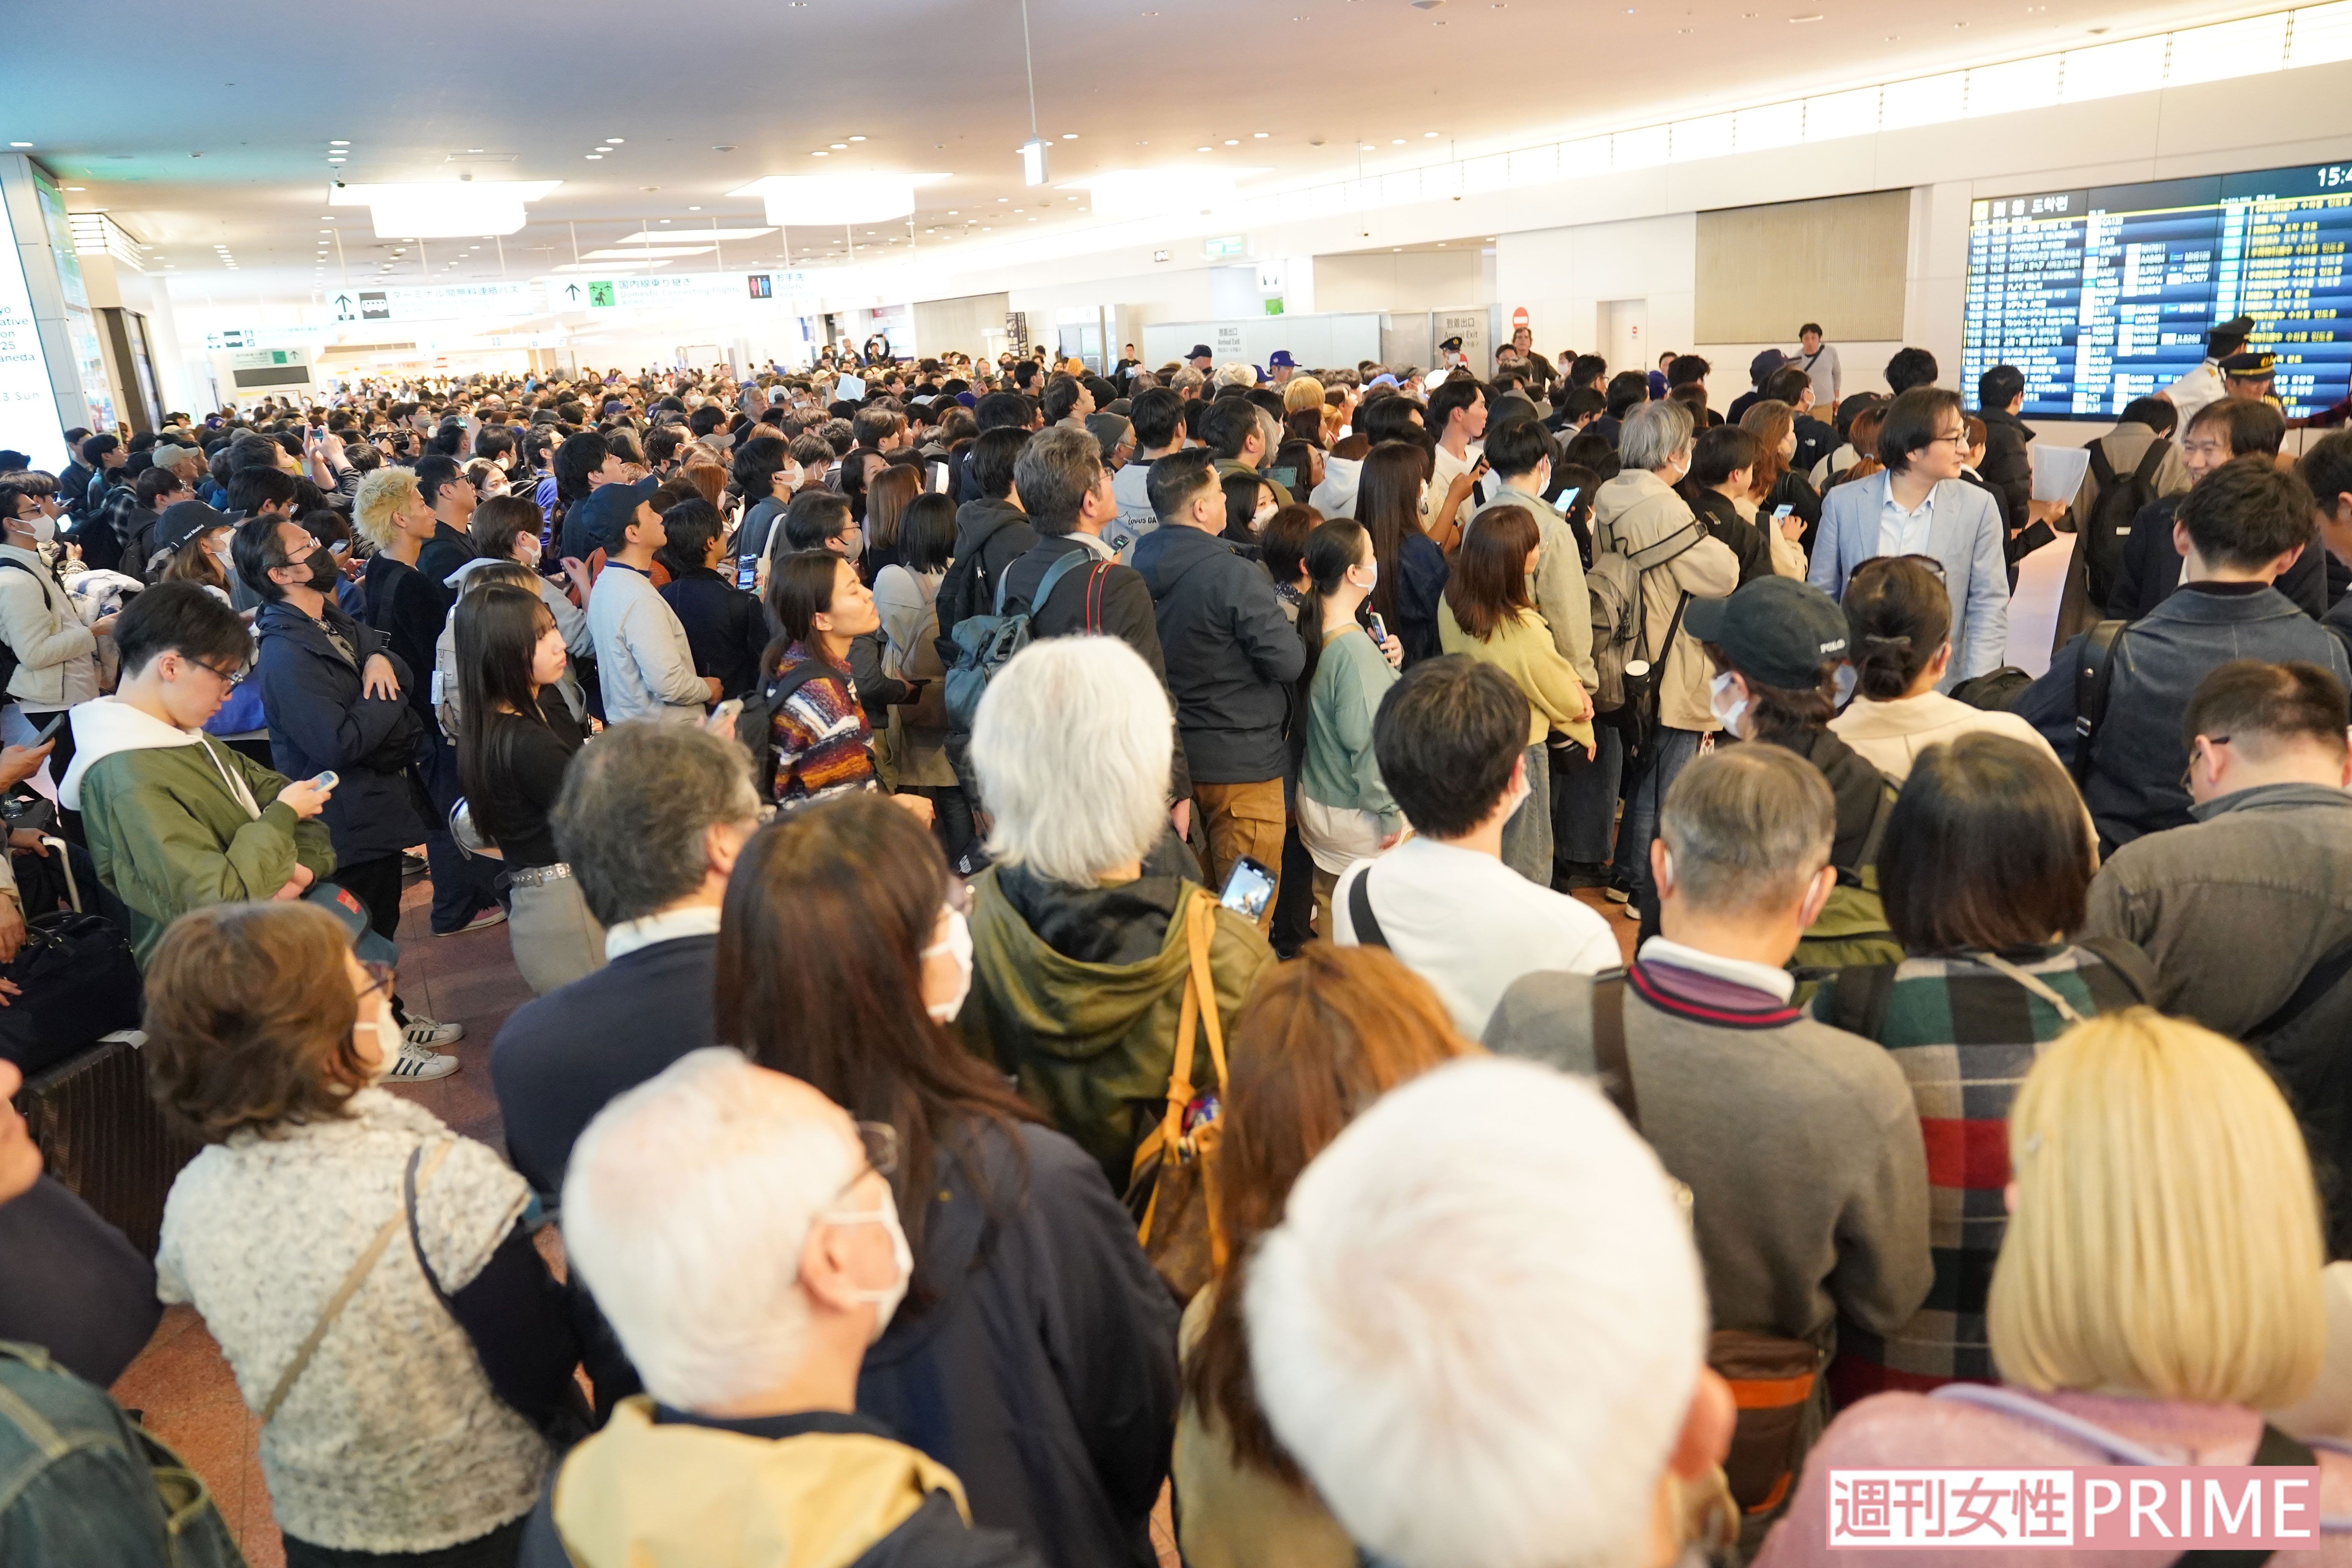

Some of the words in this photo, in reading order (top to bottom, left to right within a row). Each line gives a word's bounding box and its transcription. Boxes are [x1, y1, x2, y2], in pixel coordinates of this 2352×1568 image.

[776, 273, 804, 281] お手洗
[619, 277, 691, 289] 国内線乗り継ぎ
[393, 286, 518, 299] ターミナル間無料連絡バス
[663, 288, 709, 296] Connecting
[15, 392, 39, 400] Sun
